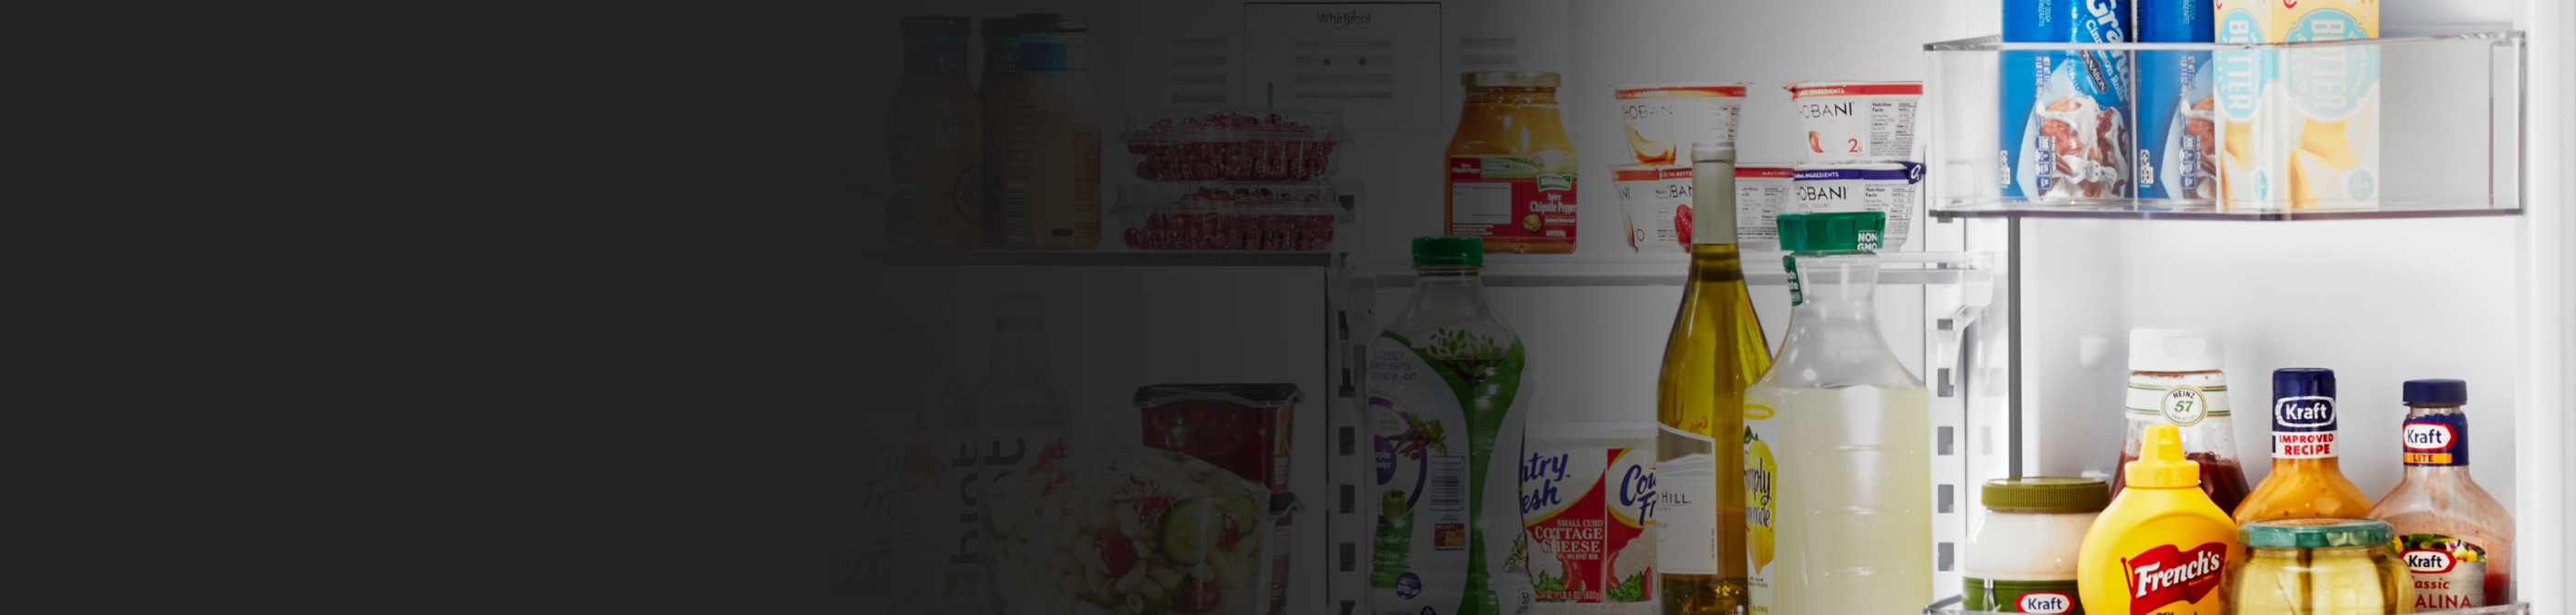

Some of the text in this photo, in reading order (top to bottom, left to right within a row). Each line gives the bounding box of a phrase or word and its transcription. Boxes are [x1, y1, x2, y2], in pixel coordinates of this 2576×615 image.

[1317, 11, 1371, 28] Whirlpool
[2311, 18, 2348, 110] BUTTER
[2351, 63, 2367, 95] CREAM
[2110, 74, 2125, 102] Rolls
[1800, 101, 1853, 119] OBANI
[935, 120, 961, 133] ICED
[935, 133, 972, 148] COFFEE
[1547, 192, 1561, 202] Spicy
[1797, 186, 1846, 201] OBANI
[1529, 201, 1577, 215] Chipotle Pepper
[1857, 233, 1878, 242] NON
[1857, 242, 1878, 251] GMO
[2172, 389, 2196, 400] HEINZ
[2174, 400, 2194, 412] 57
[2285, 402, 2328, 420] Kraft
[2171, 413, 2198, 422] VARIETIES
[2279, 433, 2334, 444] IMPROVED
[2407, 429, 2443, 444] Kraft
[1375, 449, 1392, 461] rple
[2284, 444, 2330, 456] RECIPE
[2413, 454, 2434, 463] LITE
[1523, 452, 1569, 482] ntry
[1745, 456, 1773, 506] mply
[855, 475, 901, 523] Frig
[1522, 479, 1562, 514] esh
[1557, 519, 1604, 528] SMALL CURD
[1535, 526, 1604, 540] COTTAGE
[1541, 540, 1601, 554] CHEESE
[838, 554, 893, 580] RICO
[2409, 554, 2443, 568] Kraft
[2133, 550, 2220, 598] French's
[858, 580, 891, 592] CHEE
[2414, 577, 2450, 590] assic
[2028, 597, 2062, 609] Kraft
[2415, 594, 2472, 609] ALINA
